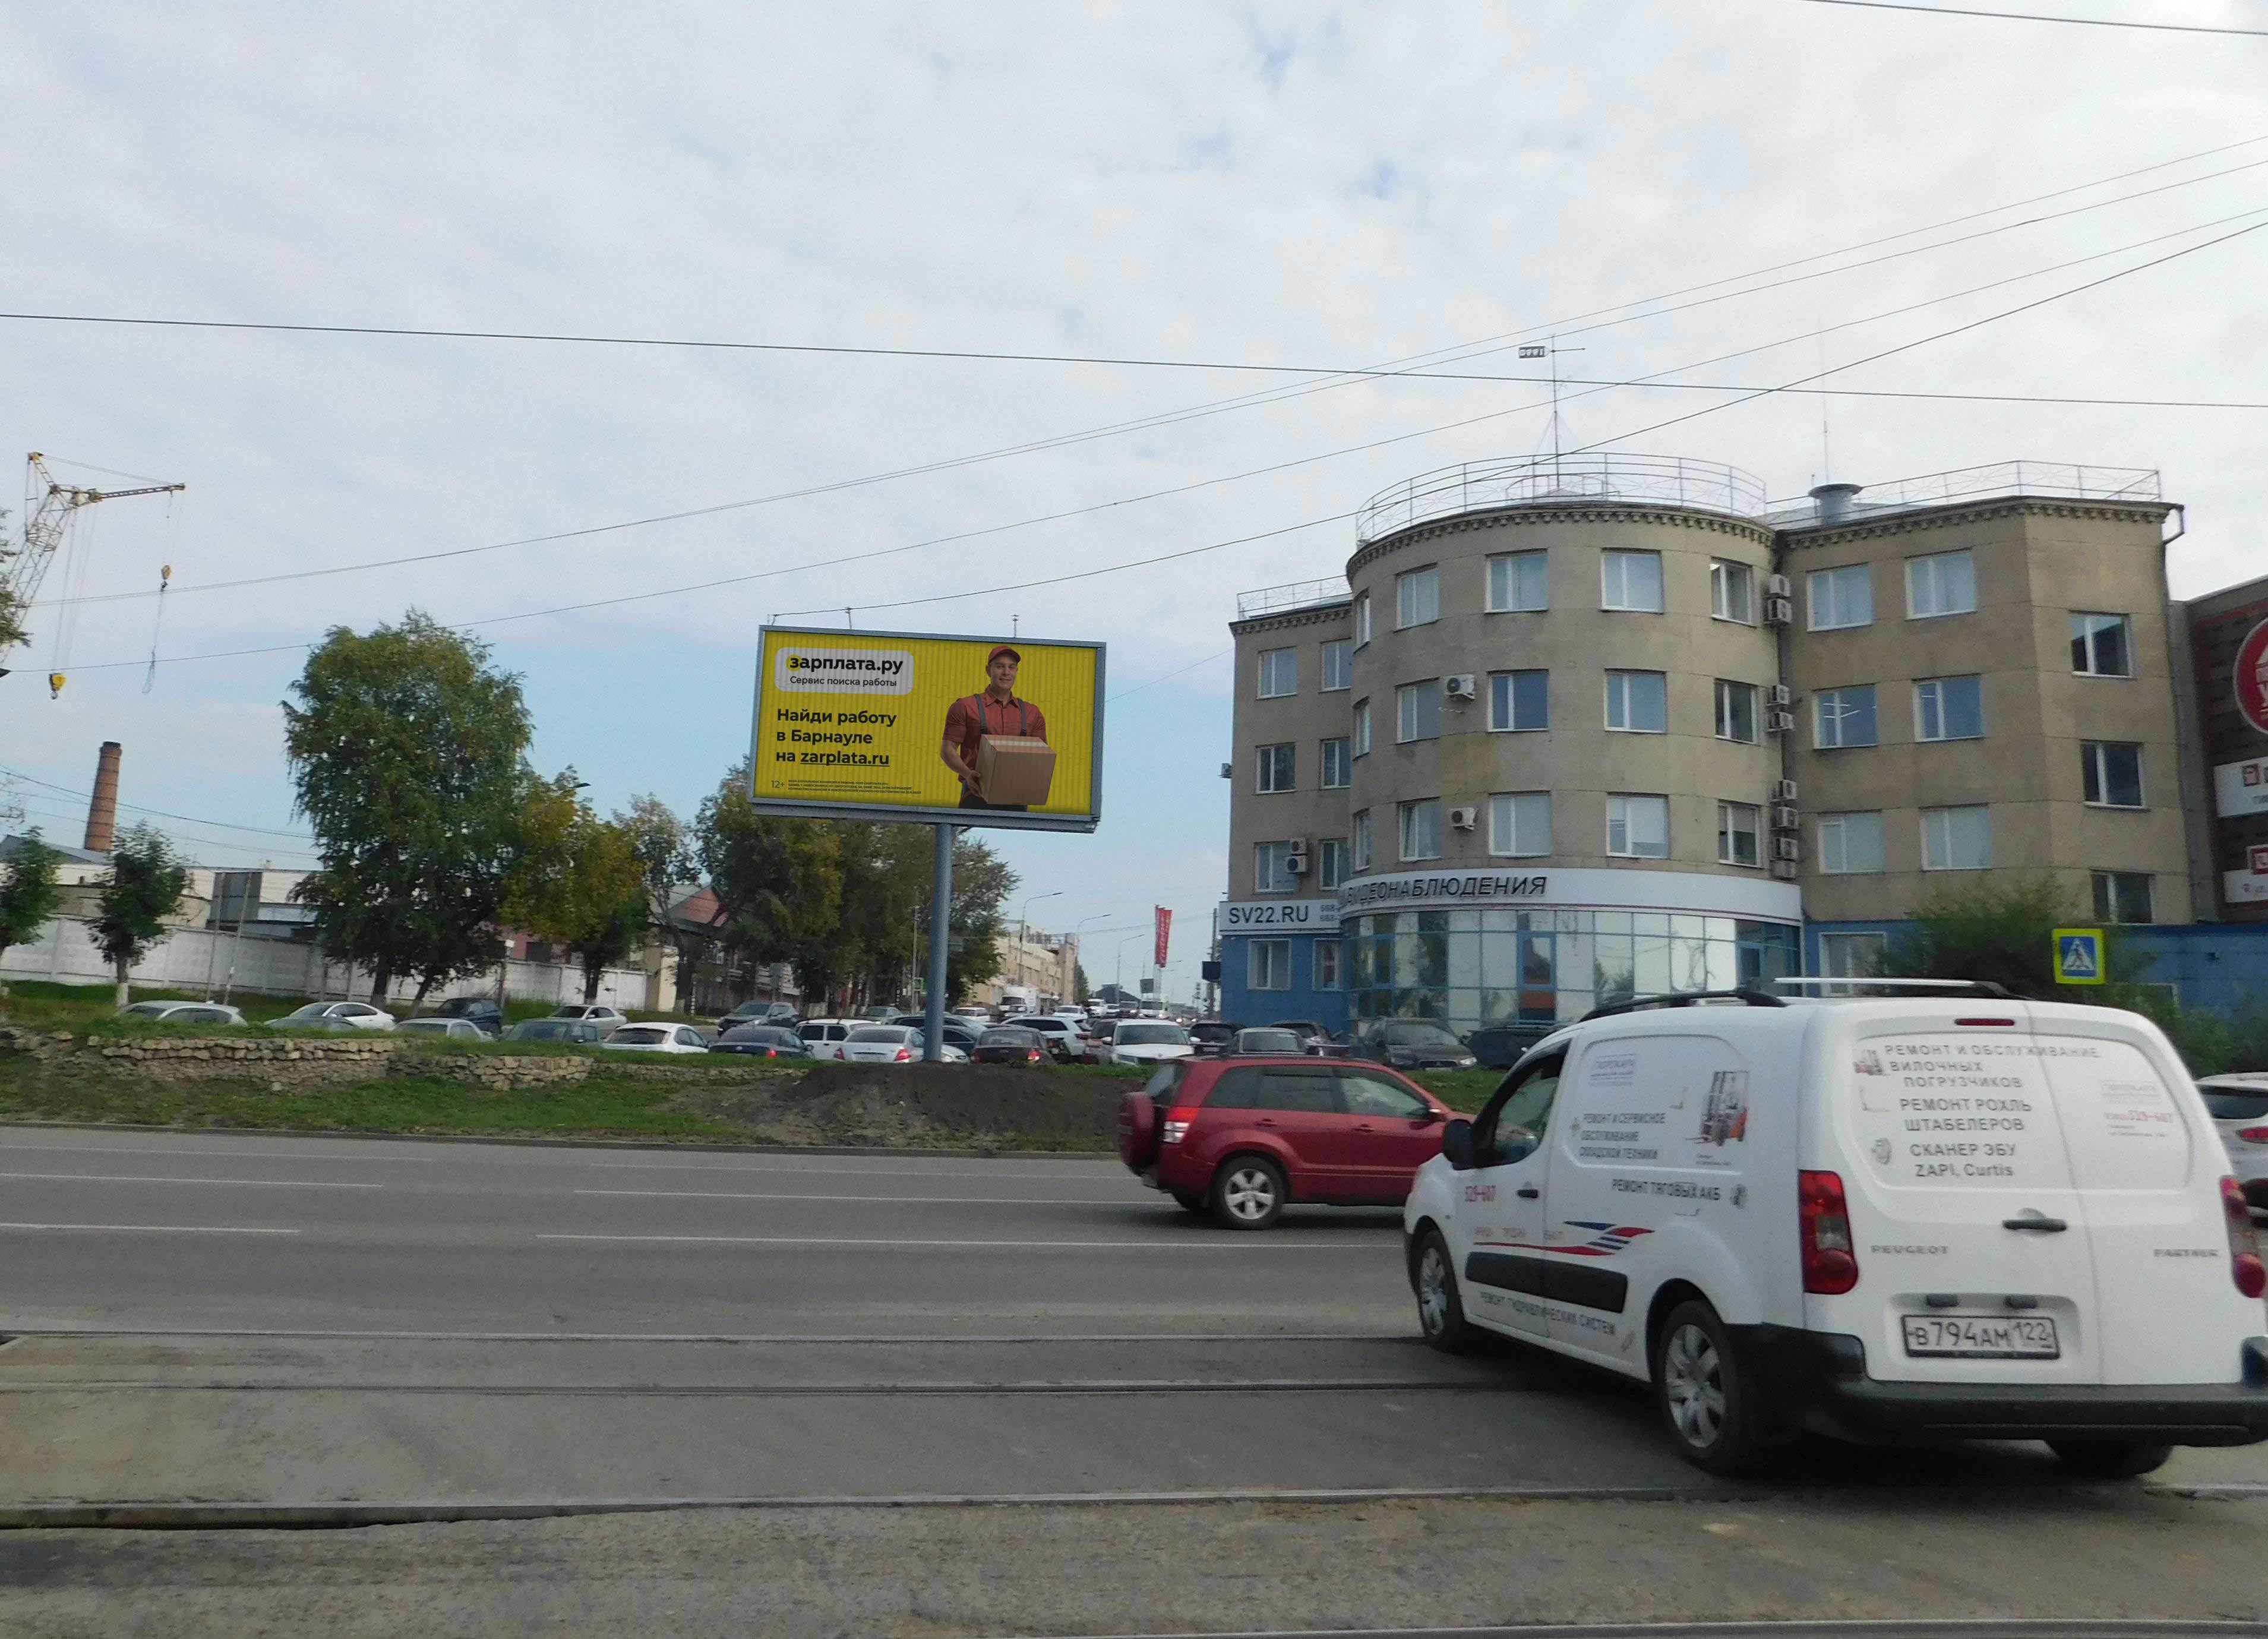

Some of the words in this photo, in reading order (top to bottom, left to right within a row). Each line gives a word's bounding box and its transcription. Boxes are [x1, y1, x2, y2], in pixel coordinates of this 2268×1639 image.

[790, 657, 903, 674] зарплата.ру
[790, 676, 825, 686] Сервис
[863, 678, 896, 687] работы
[777, 709, 832, 724] Найди
[838, 710, 896, 727] работу
[777, 731, 786, 741] в
[791, 730, 873, 746] Барнауле
[776, 751, 795, 761] на
[800, 751, 889, 766] zarplata.ru
[1228, 905, 1310, 924] SV22.RU
[1885, 1045, 1950, 1055] РЕМОНТ
[1959, 1045, 1967, 1055] И
[1971, 1045, 2100, 1058] ОБСЛУЖИВАНИЕ
[1890, 1062, 1983, 1072] ВИЛОЧНЫХ
[1903, 1076, 2023, 1088] ПОГРУЗЧИКОВ
[1900, 1098, 1970, 1111] РЕМОНТ
[1976, 1099, 2032, 1111] РОХЛЬ
[1904, 1118, 2025, 1131] ШТАБЕЛЕРОВ
[1910, 1144, 1978, 1156] СКАНЕР
[1984, 1144, 2017, 1156] ЭБУ
[1963, 1164, 2014, 1176] Curtis
[1871, 1245, 1948, 1254] PEUGEOT
